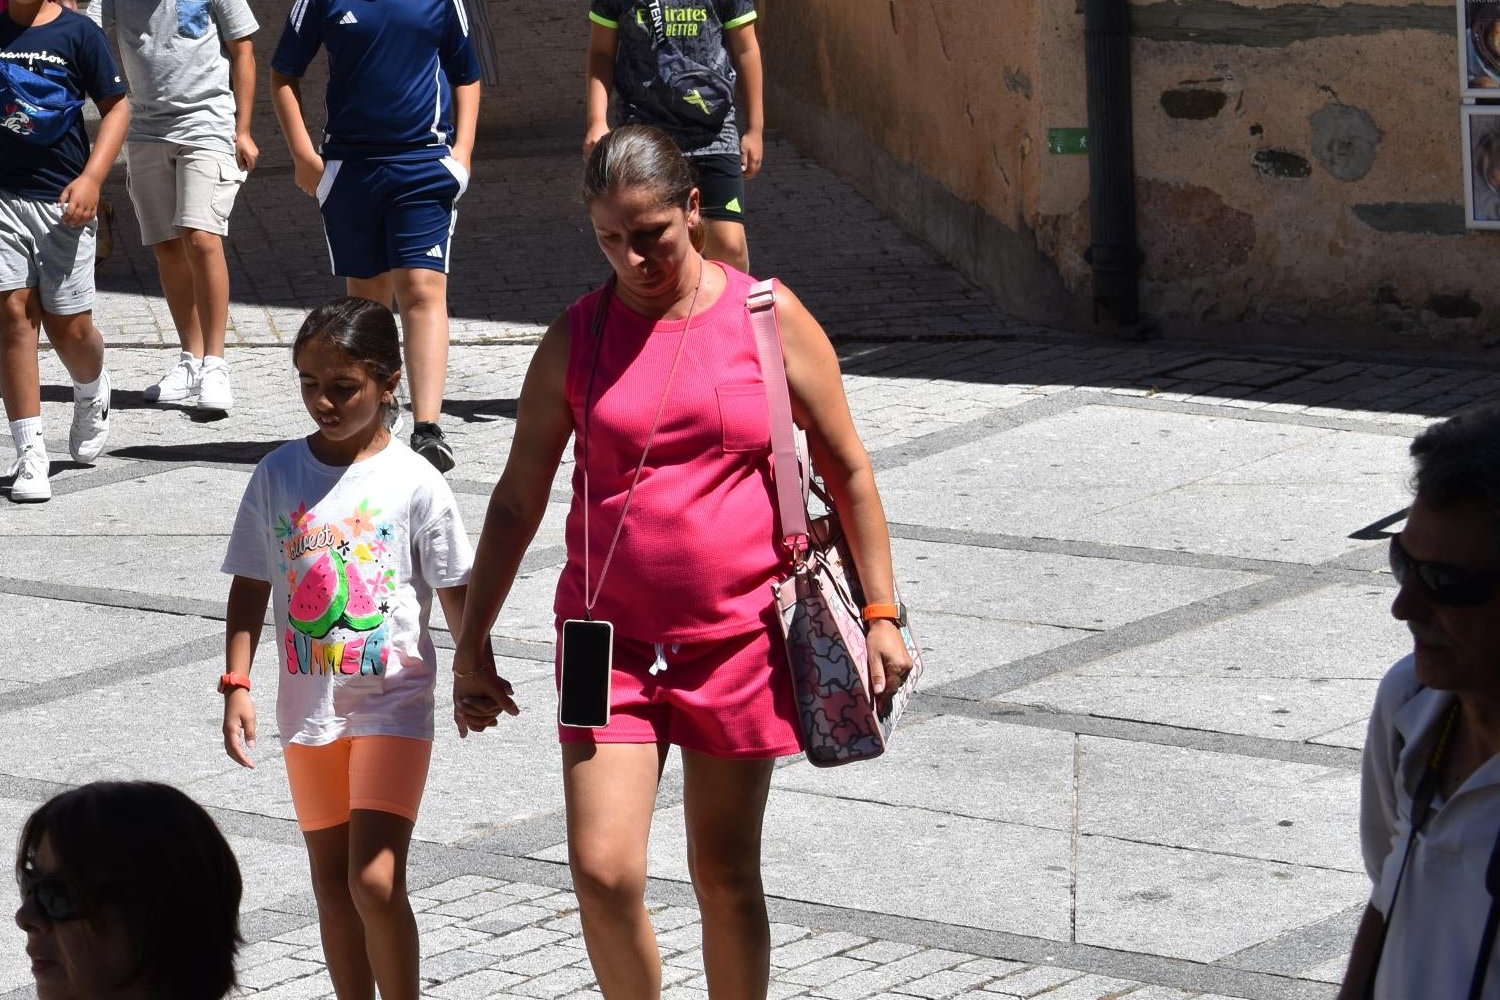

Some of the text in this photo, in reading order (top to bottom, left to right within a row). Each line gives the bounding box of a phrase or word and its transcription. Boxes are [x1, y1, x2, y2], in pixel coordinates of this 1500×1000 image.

[636, 5, 708, 25] Eirates
[648, 0, 666, 44] TENTH
[665, 23, 699, 37] BETTER
[289, 524, 336, 561] sweet
[285, 625, 389, 675] SUMMER
